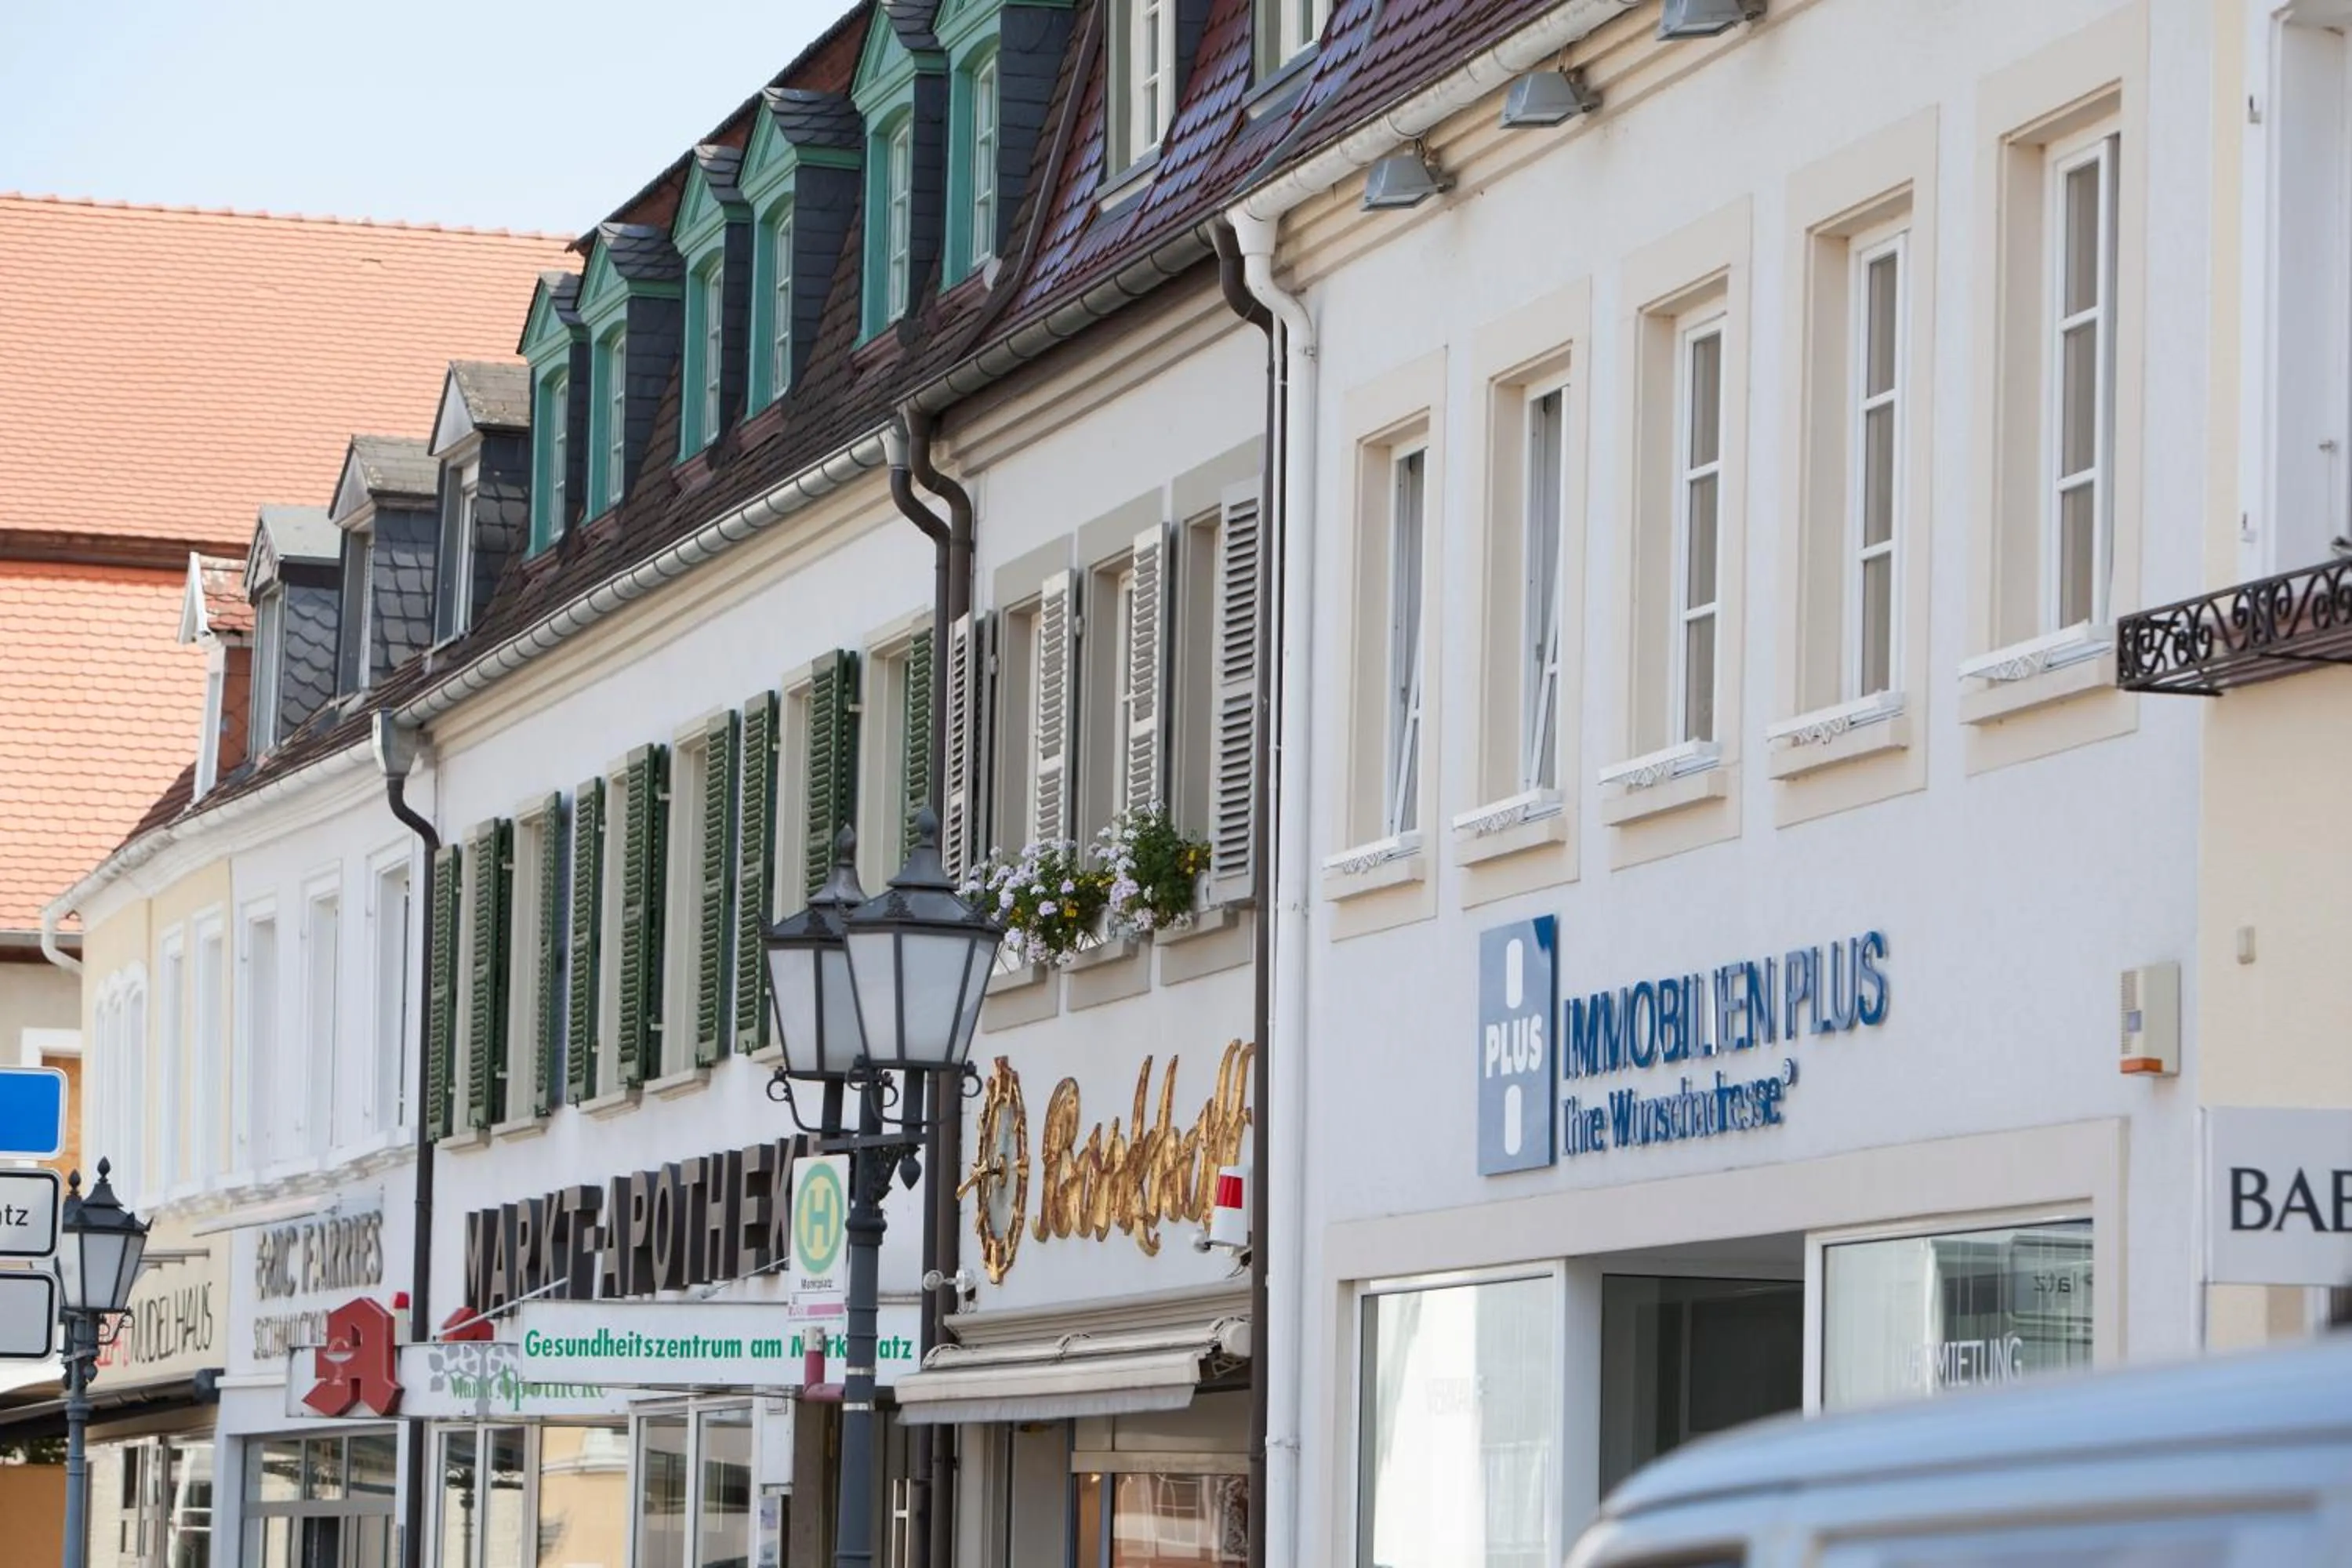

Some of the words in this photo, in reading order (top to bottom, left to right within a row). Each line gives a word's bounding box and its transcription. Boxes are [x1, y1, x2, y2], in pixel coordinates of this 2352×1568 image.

[1563, 955, 1778, 1080] IMMOBILIEN
[1785, 930, 1891, 1040] PLUS
[1485, 1014, 1543, 1079] PLUS
[1562, 1095, 1606, 1156] Ihre
[0, 1203, 29, 1227] tz
[464, 1132, 820, 1319] MARKT-APOTHEK
[806, 1188, 832, 1249] H
[524, 1328, 742, 1359] Gesundheitszentrum
[750, 1338, 782, 1359] am
[789, 1334, 913, 1360] Mrkatz
